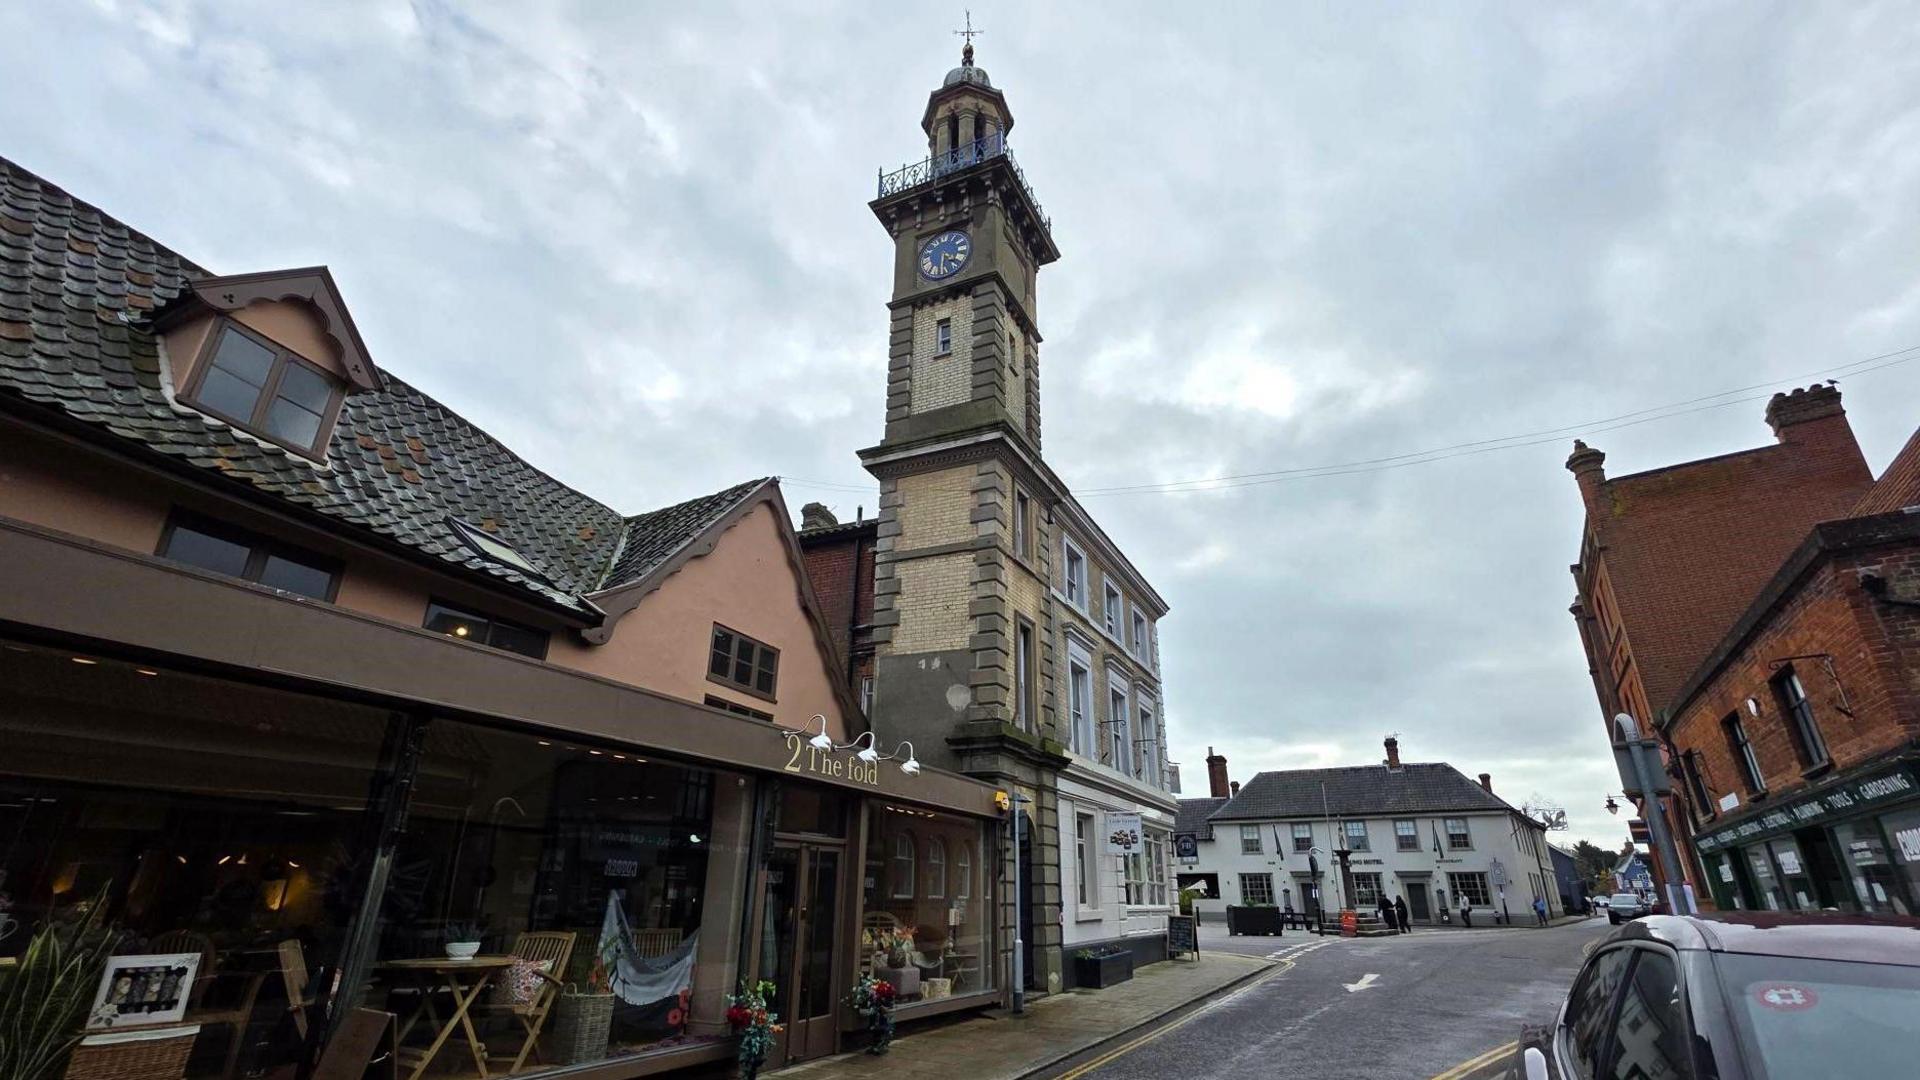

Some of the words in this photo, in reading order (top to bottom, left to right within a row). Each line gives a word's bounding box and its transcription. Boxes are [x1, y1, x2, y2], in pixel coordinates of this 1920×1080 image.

[784, 735, 801, 772] 2
[805, 744, 842, 777] The
[848, 756, 878, 785] fold
[1827, 791, 1854, 809] TOOLS
[1859, 773, 1911, 799] GARDENING
